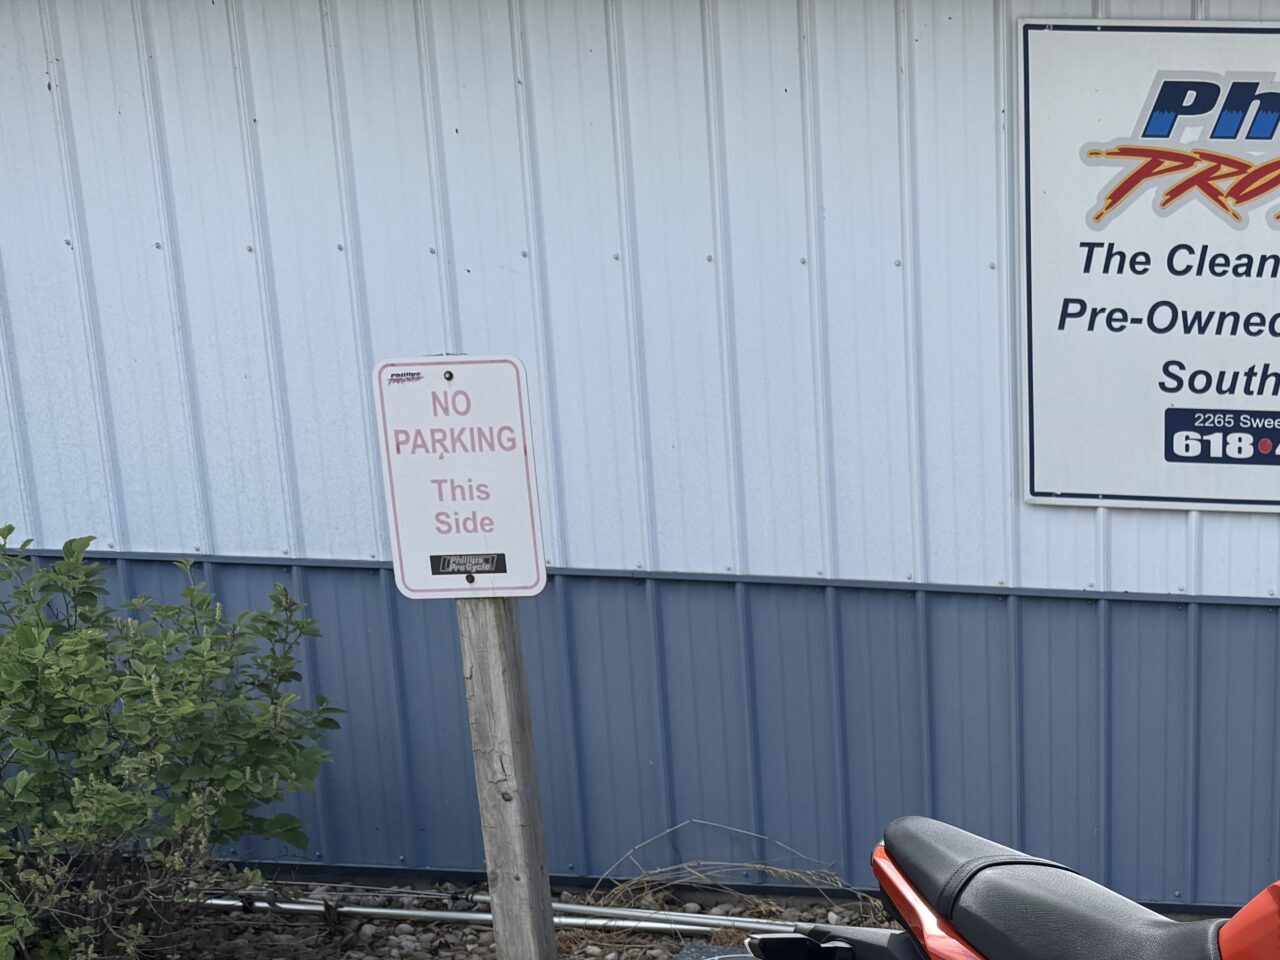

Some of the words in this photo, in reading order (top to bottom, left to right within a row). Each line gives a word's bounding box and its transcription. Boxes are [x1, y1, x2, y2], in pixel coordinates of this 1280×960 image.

[1079, 241, 1152, 276] The
[431, 390, 472, 417] NO
[1194, 413, 1235, 428] 2265
[393, 425, 517, 455] PARKING
[431, 478, 491, 502] This
[434, 511, 495, 534] Side
